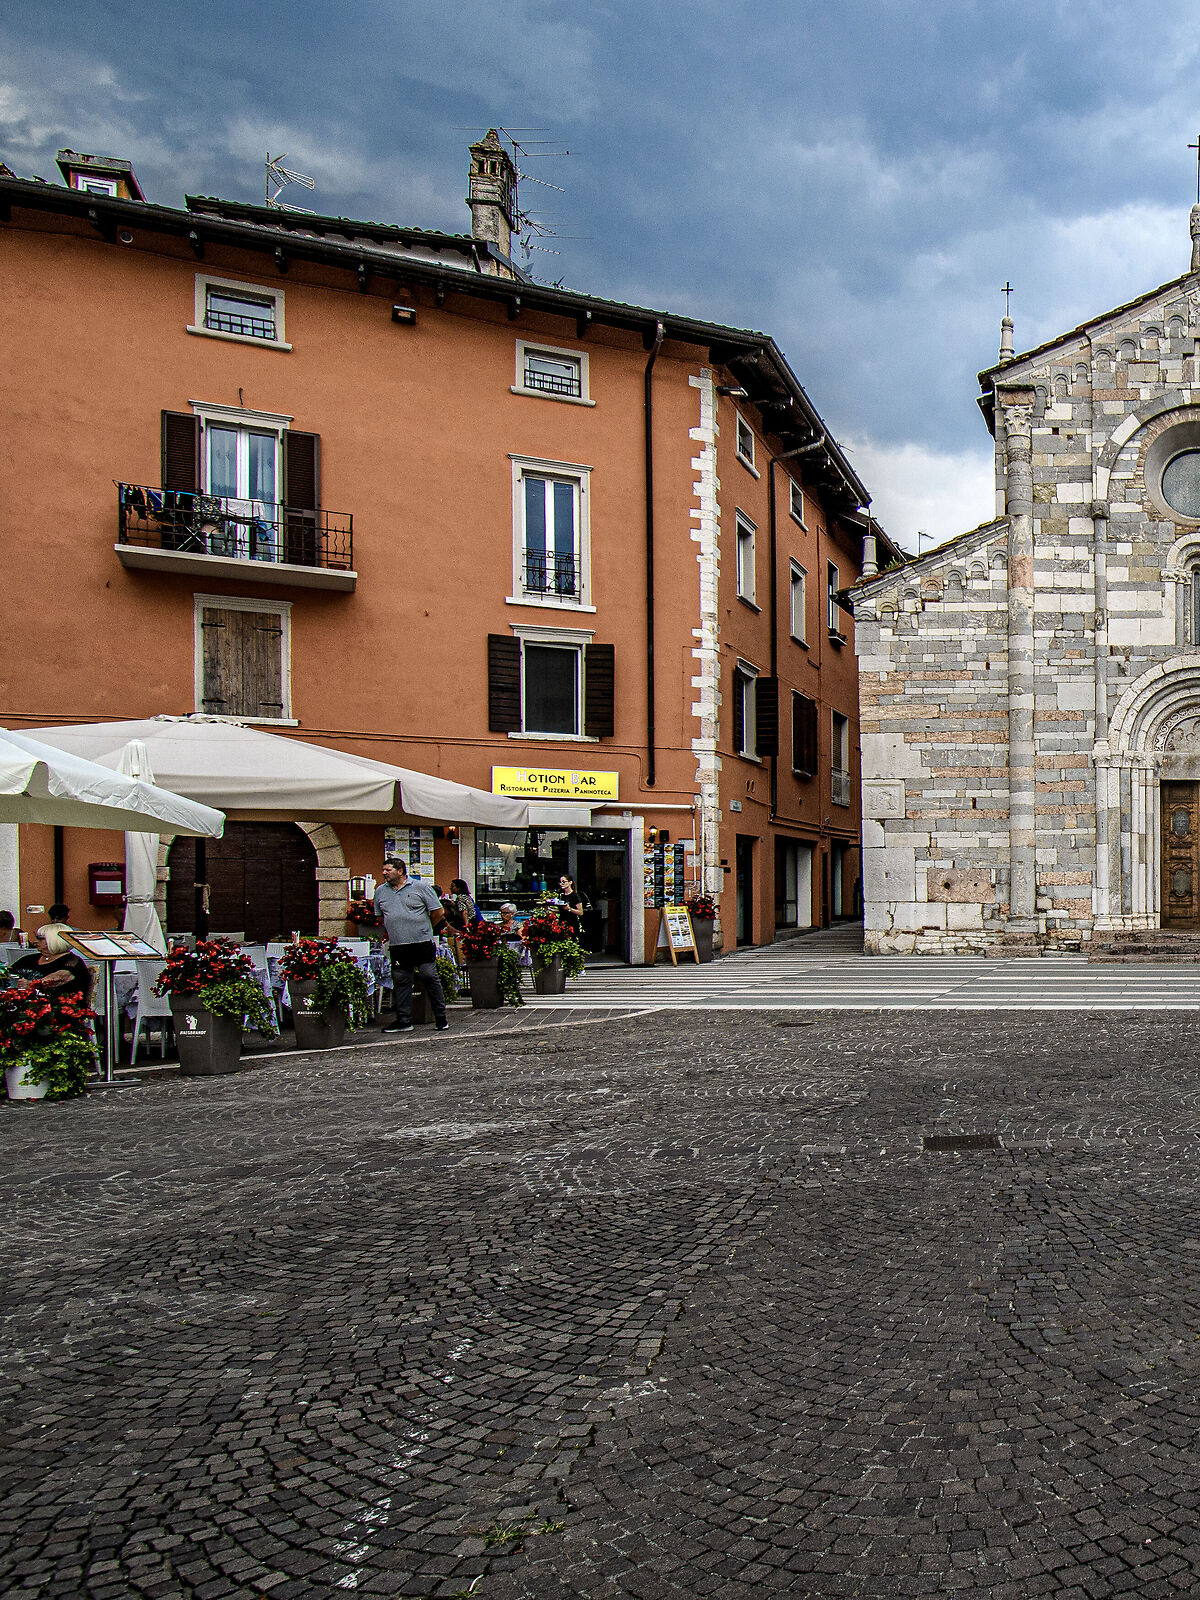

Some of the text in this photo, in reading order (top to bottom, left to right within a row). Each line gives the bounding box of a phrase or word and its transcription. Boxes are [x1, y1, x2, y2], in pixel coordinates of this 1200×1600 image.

[516, 770, 597, 785] HOTION BAR
[500, 784, 612, 795] RISTORANTE PIZZERIA PANINOTECA
